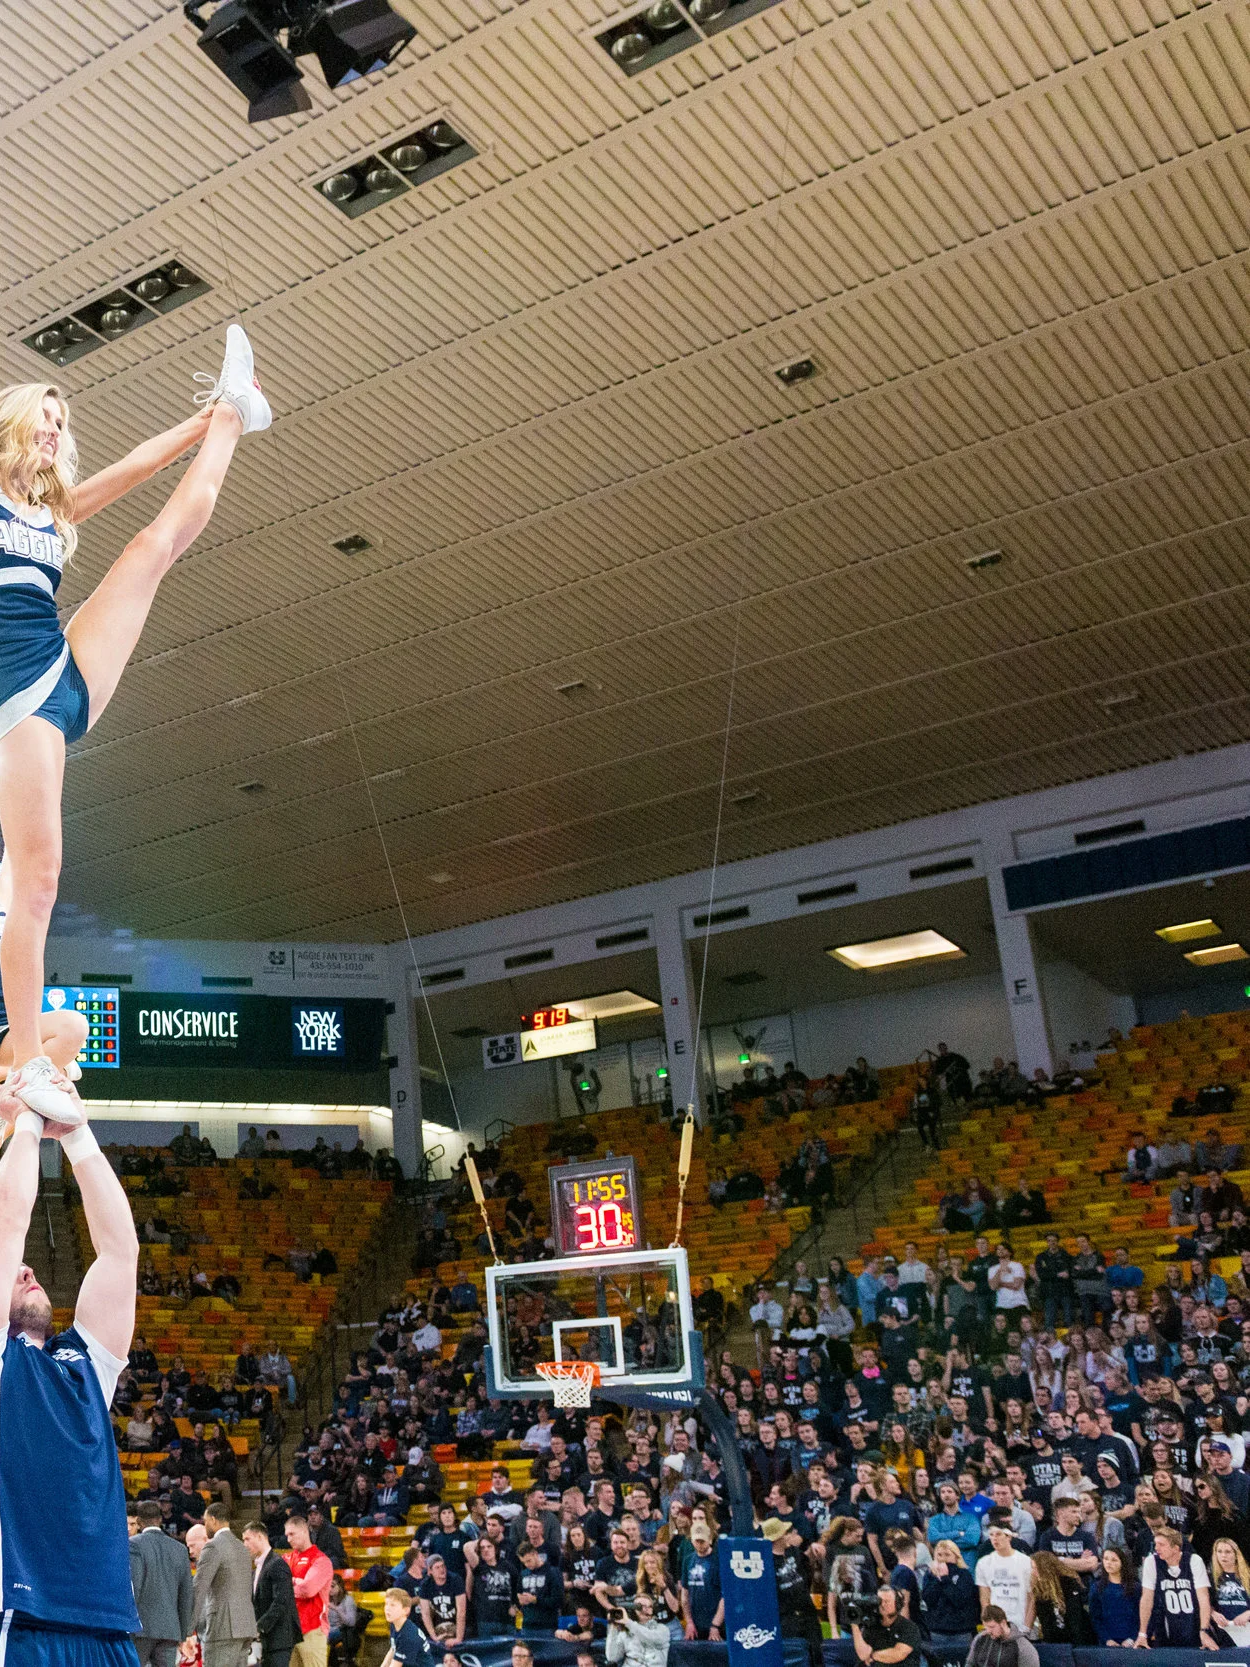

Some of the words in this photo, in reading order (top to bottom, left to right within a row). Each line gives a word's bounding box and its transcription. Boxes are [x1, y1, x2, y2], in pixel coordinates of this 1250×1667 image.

[298, 952, 321, 961] AGGIE
[323, 953, 338, 961] FAN
[339, 953, 358, 962] TEXT
[359, 953, 375, 963] LINE
[1014, 978, 1027, 996] F
[300, 1011, 337, 1025] NEW
[294, 1023, 342, 1039] YORK
[159, 1040, 207, 1048] management
[216, 1041, 238, 1049] billing
[301, 1036, 338, 1051] LIFE
[674, 1040, 685, 1055] E
[396, 1090, 407, 1104] D
[573, 1174, 626, 1203] 11:55
[575, 1203, 623, 1250] 30
[1032, 1463, 1061, 1476] UTAH
[1034, 1476, 1062, 1487] STATE
[1164, 1590, 1194, 1614] 00
